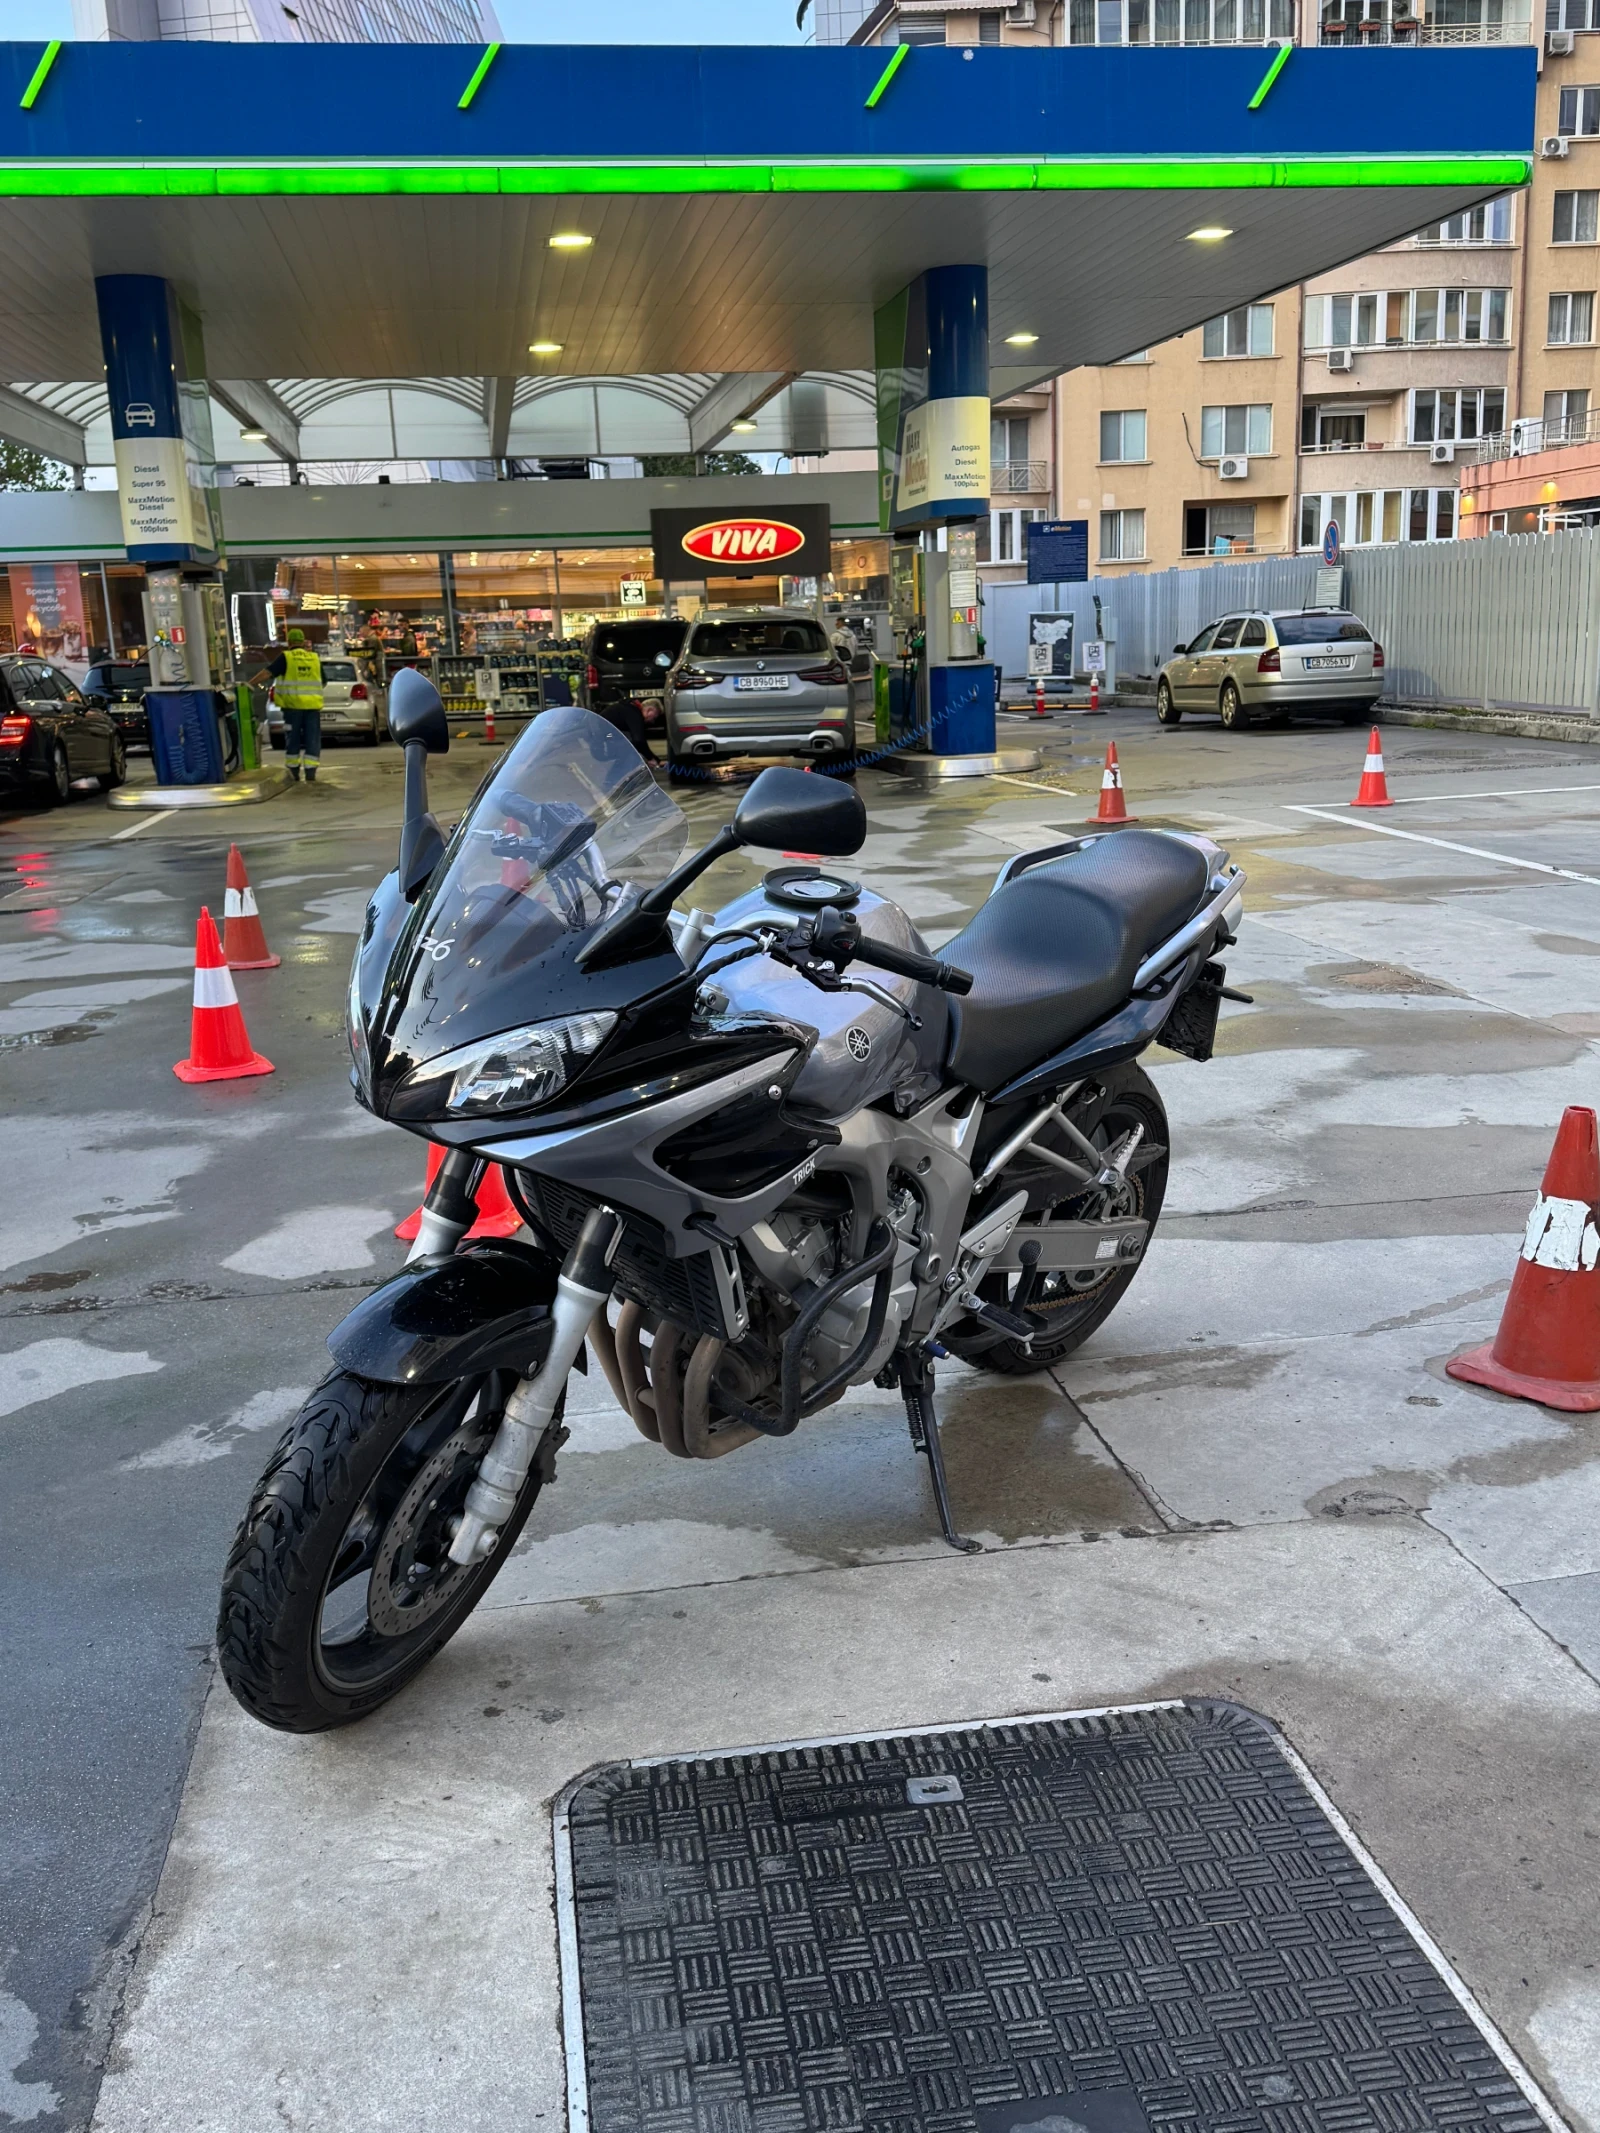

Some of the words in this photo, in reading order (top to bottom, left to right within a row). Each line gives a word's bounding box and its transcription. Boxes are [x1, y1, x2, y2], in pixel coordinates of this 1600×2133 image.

[951, 444, 981, 453] Autogas
[134, 465, 160, 473] Diesel
[132, 480, 153, 489] Super
[954, 480, 979, 488] 100plus
[128, 496, 175, 504] MaxxMotion
[131, 517, 178, 526] MaxxMotion
[140, 525, 169, 533] 100plus
[711, 527, 778, 556] VIVA
[629, 572, 653, 581] VIVA
[740, 678, 752, 688] CB
[792, 1157, 816, 1186] TRICK
